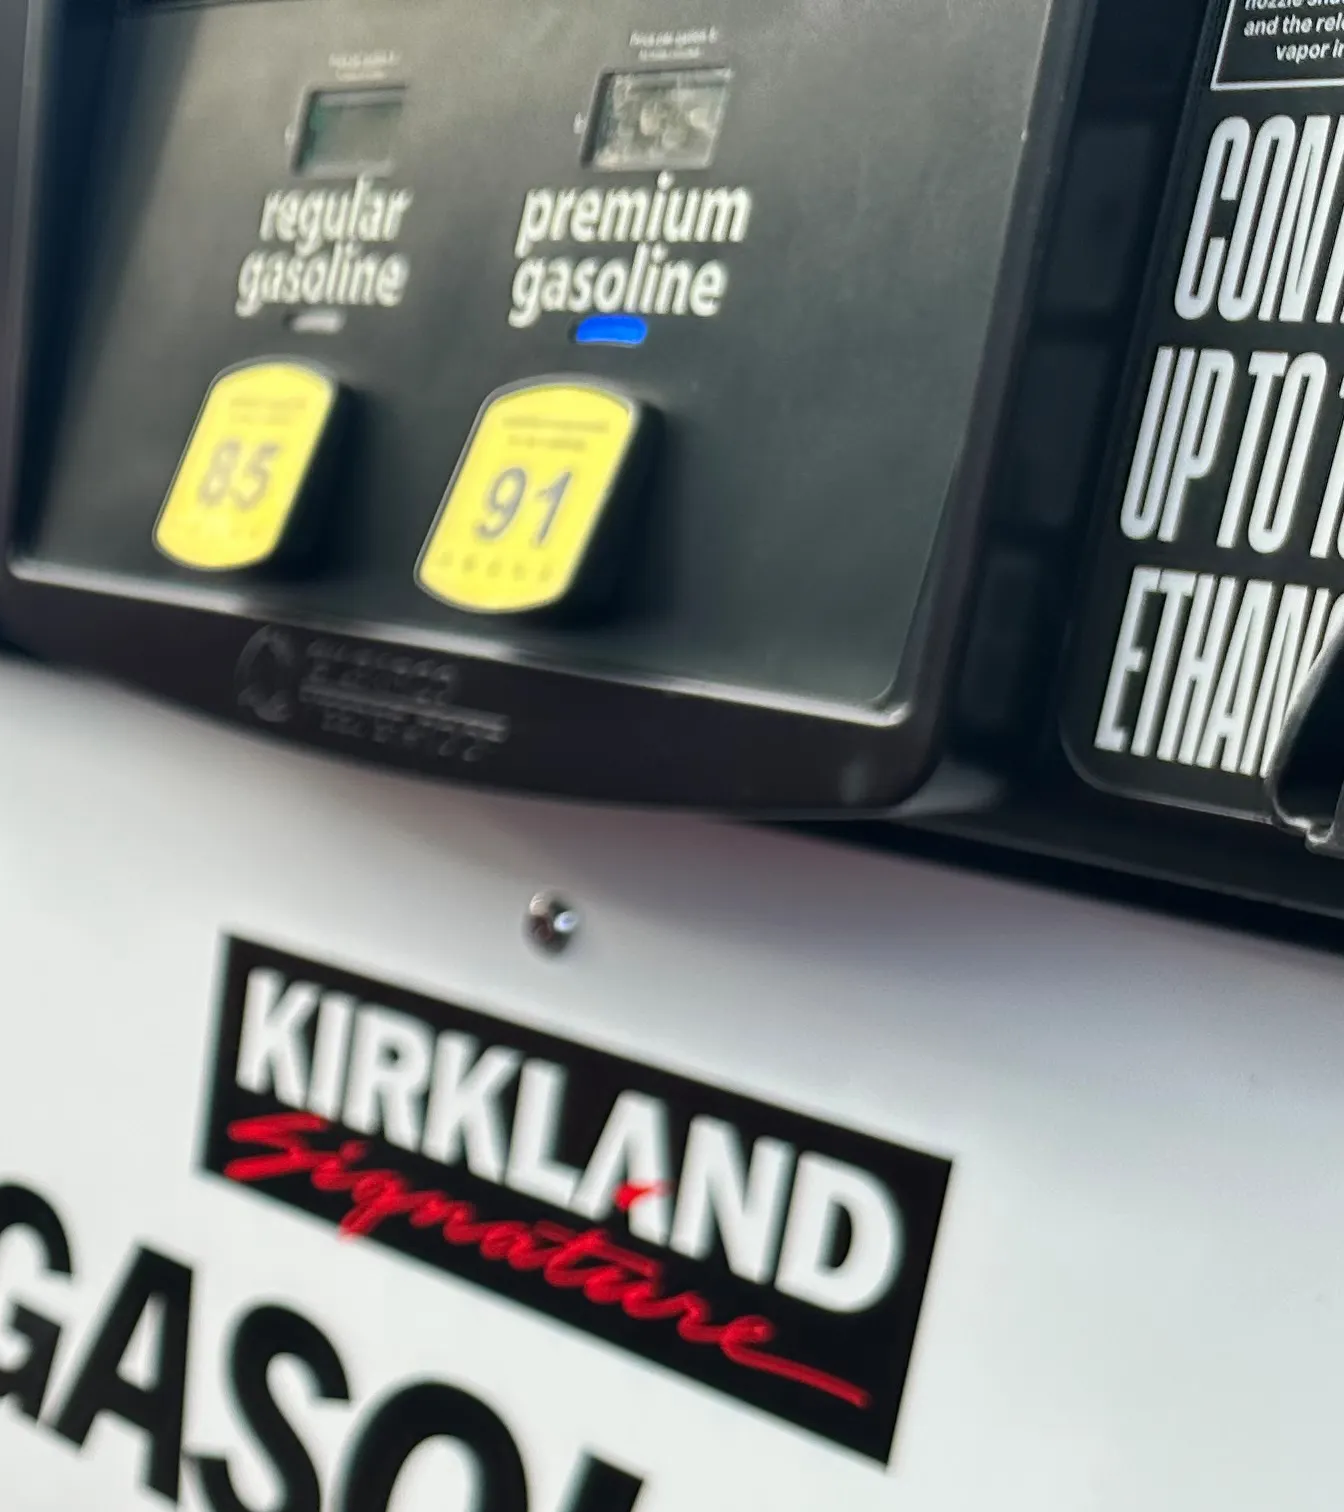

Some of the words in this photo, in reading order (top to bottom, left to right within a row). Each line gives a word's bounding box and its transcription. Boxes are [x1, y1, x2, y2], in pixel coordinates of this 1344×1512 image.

[1244, 15, 1279, 36] and
[1282, 14, 1312, 34] the
[1315, 12, 1344, 33] rel
[1276, 43, 1330, 64] vapor
[259, 173, 413, 253] regular
[514, 170, 753, 258] premium
[235, 243, 409, 318] gasoline
[508, 244, 728, 328] gasoline
[199, 437, 279, 511] 85
[1120, 346, 1235, 543] UP
[1216, 351, 1327, 554] TO
[473, 465, 574, 548] 91
[1094, 564, 1344, 779] ETHAN
[235, 966, 905, 1314] KIRKLAND
[223, 1110, 872, 1408] Signature
